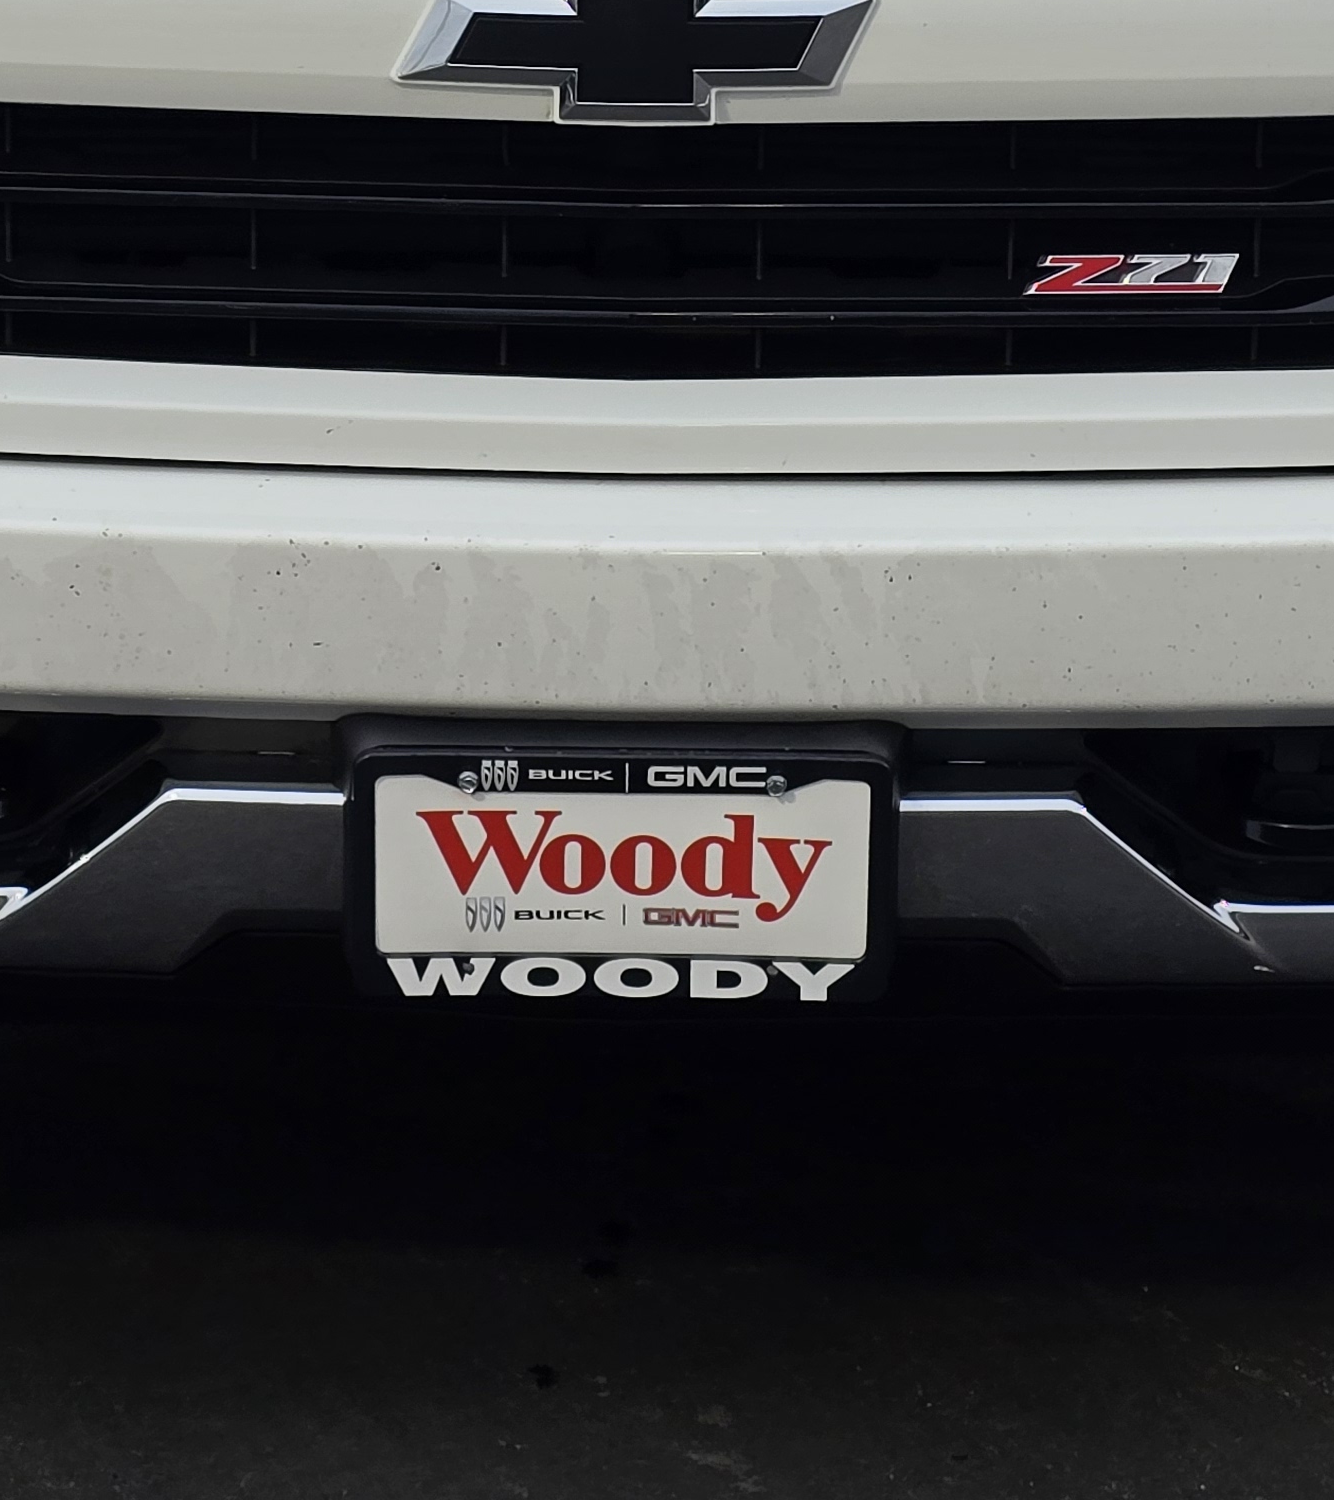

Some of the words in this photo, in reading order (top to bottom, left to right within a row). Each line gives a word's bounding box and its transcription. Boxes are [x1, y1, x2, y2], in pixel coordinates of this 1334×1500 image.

[1022, 253, 1240, 295] Z71
[527, 768, 614, 782] BUICK
[646, 765, 767, 789] GMC
[415, 810, 833, 922] Woody
[513, 908, 606, 921] BUICK
[642, 907, 739, 928] GMC
[386, 956, 856, 1001] WOODY
